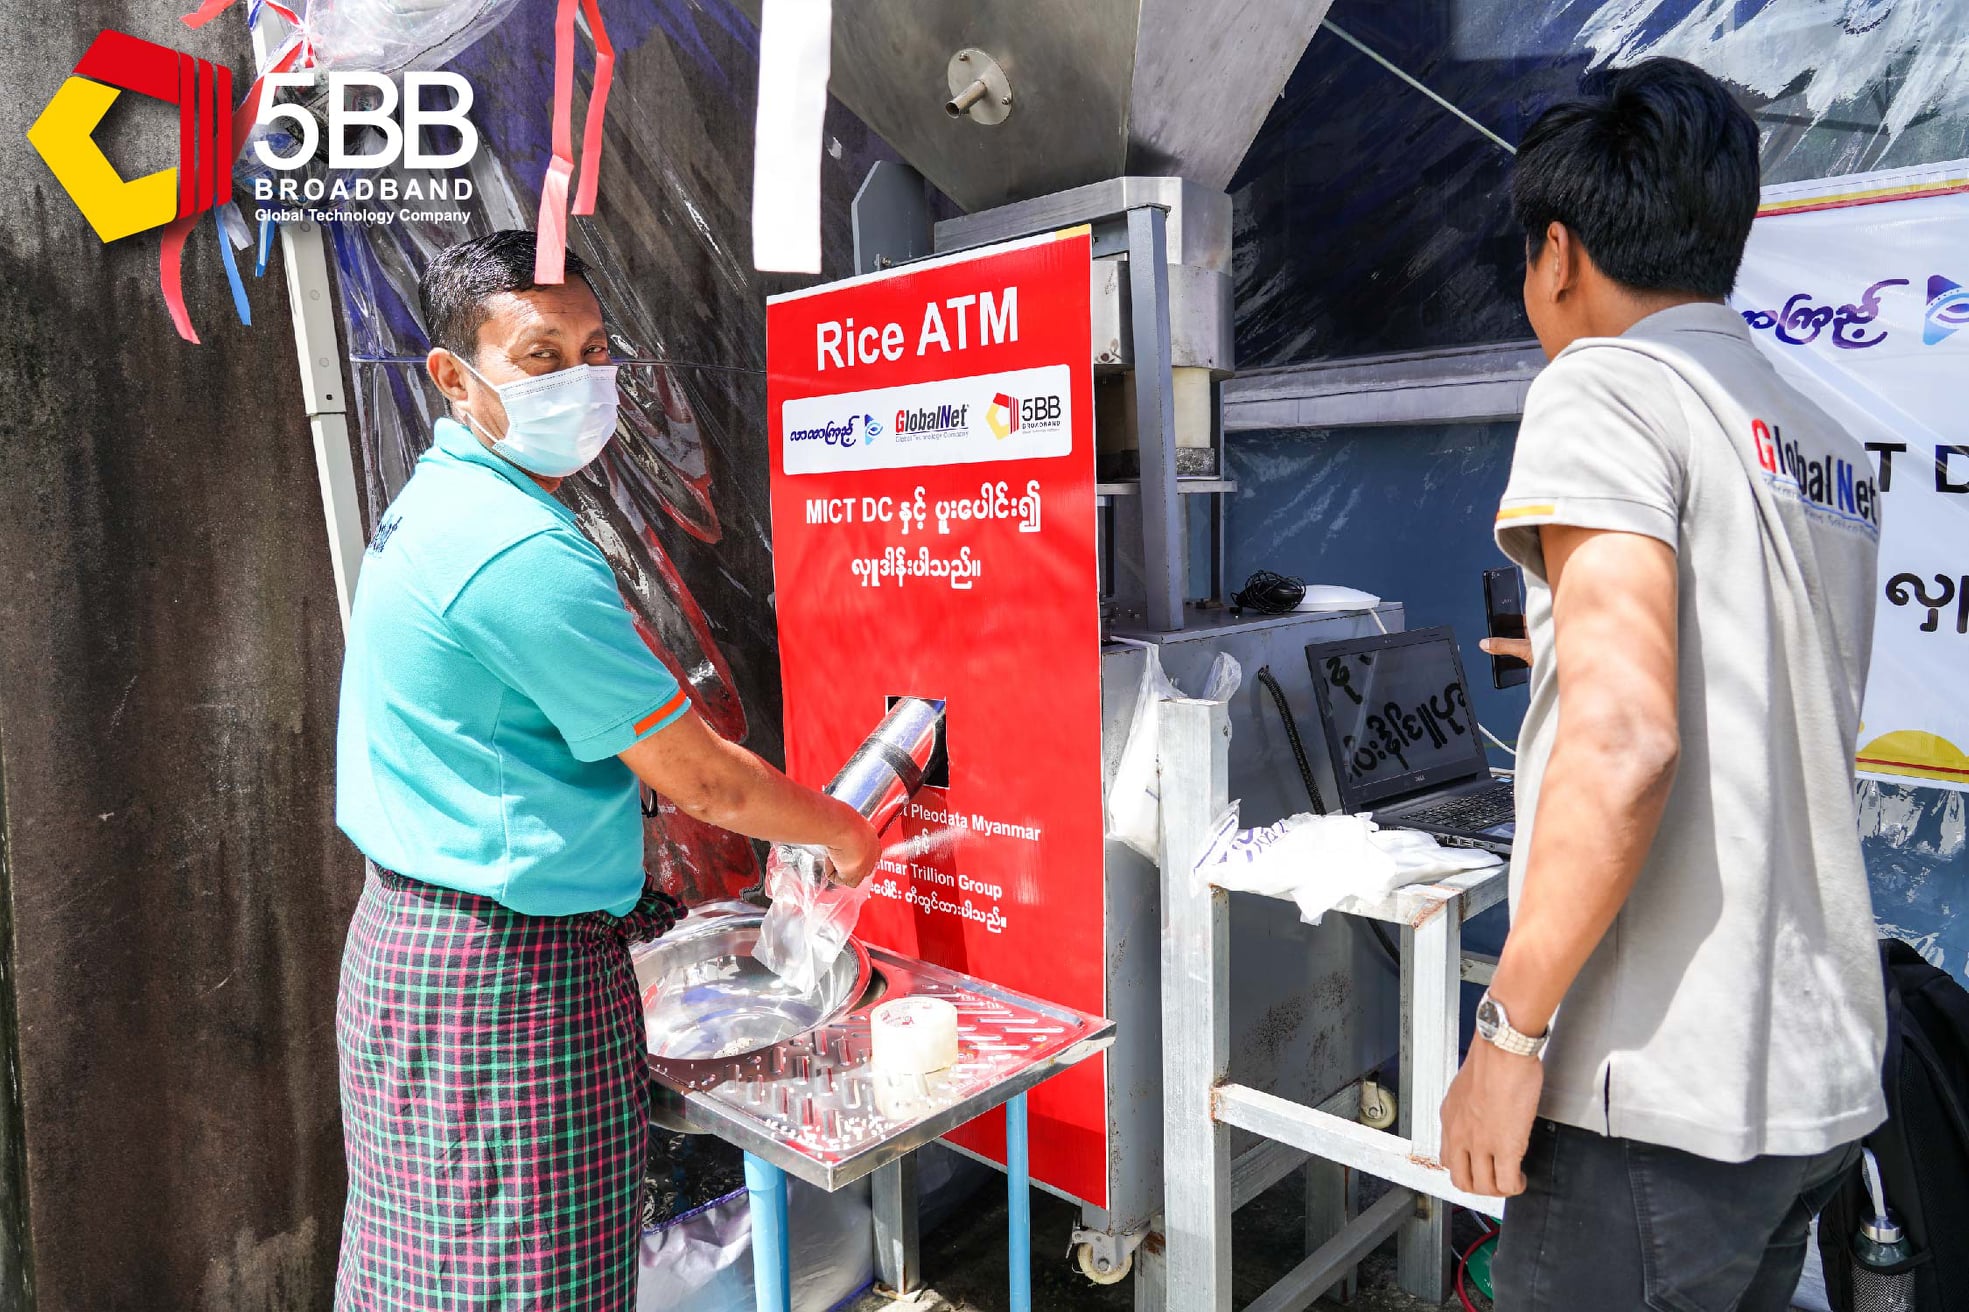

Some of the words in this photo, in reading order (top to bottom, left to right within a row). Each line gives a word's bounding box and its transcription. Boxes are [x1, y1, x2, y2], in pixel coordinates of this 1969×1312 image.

[816, 318, 905, 371] Rice
[916, 287, 1019, 356] ATM
[895, 404, 968, 433] GlobalNet
[1022, 395, 1062, 422] 5BB
[806, 498, 856, 524] MICT
[862, 496, 893, 522] DC
[911, 804, 968, 829] Pleodata
[972, 814, 1041, 842] Myanmar
[910, 863, 955, 887] Trillion
[958, 874, 1003, 902] Group
